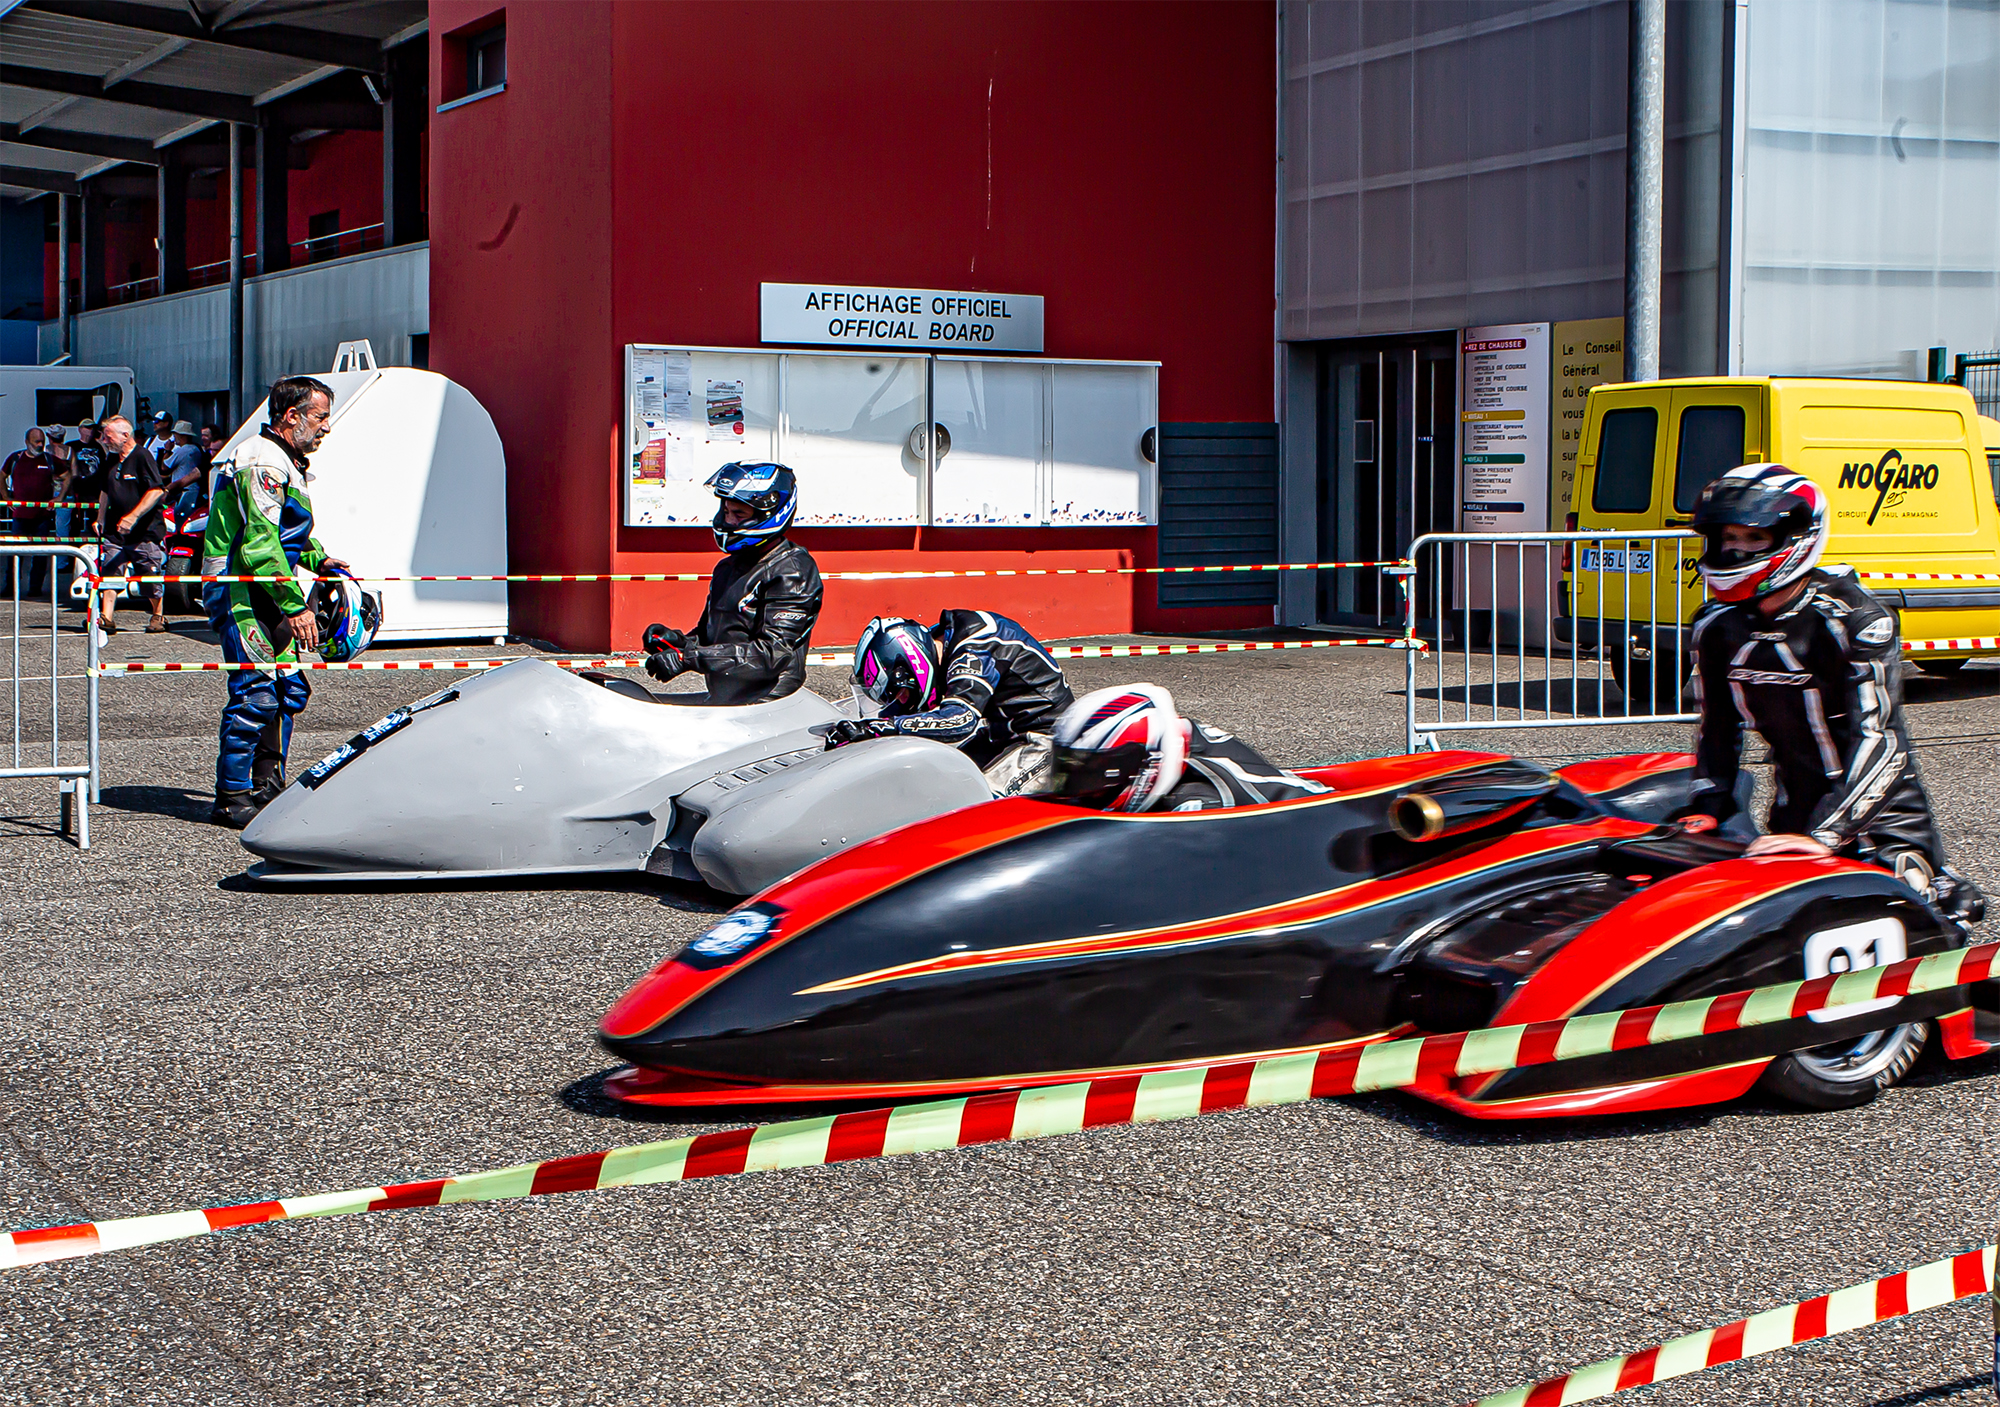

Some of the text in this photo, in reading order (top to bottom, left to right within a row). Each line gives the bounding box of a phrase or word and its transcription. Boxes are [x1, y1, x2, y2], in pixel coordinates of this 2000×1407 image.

[805, 292, 1012, 318] AFFICHAGE OFFICIEL
[828, 318, 995, 342] OFFICIAL BOARD
[1488, 341, 1522, 349] CHAUSSEE
[1562, 340, 1622, 355] Le Conseil
[1563, 363, 1600, 376] Général
[1562, 386, 1590, 397] du Ge
[1562, 410, 1584, 418] vous
[1562, 429, 1570, 440] la
[1562, 452, 1577, 461] sur
[1838, 449, 1939, 526] NOGARO
[1636, 554, 1650, 569] 32
